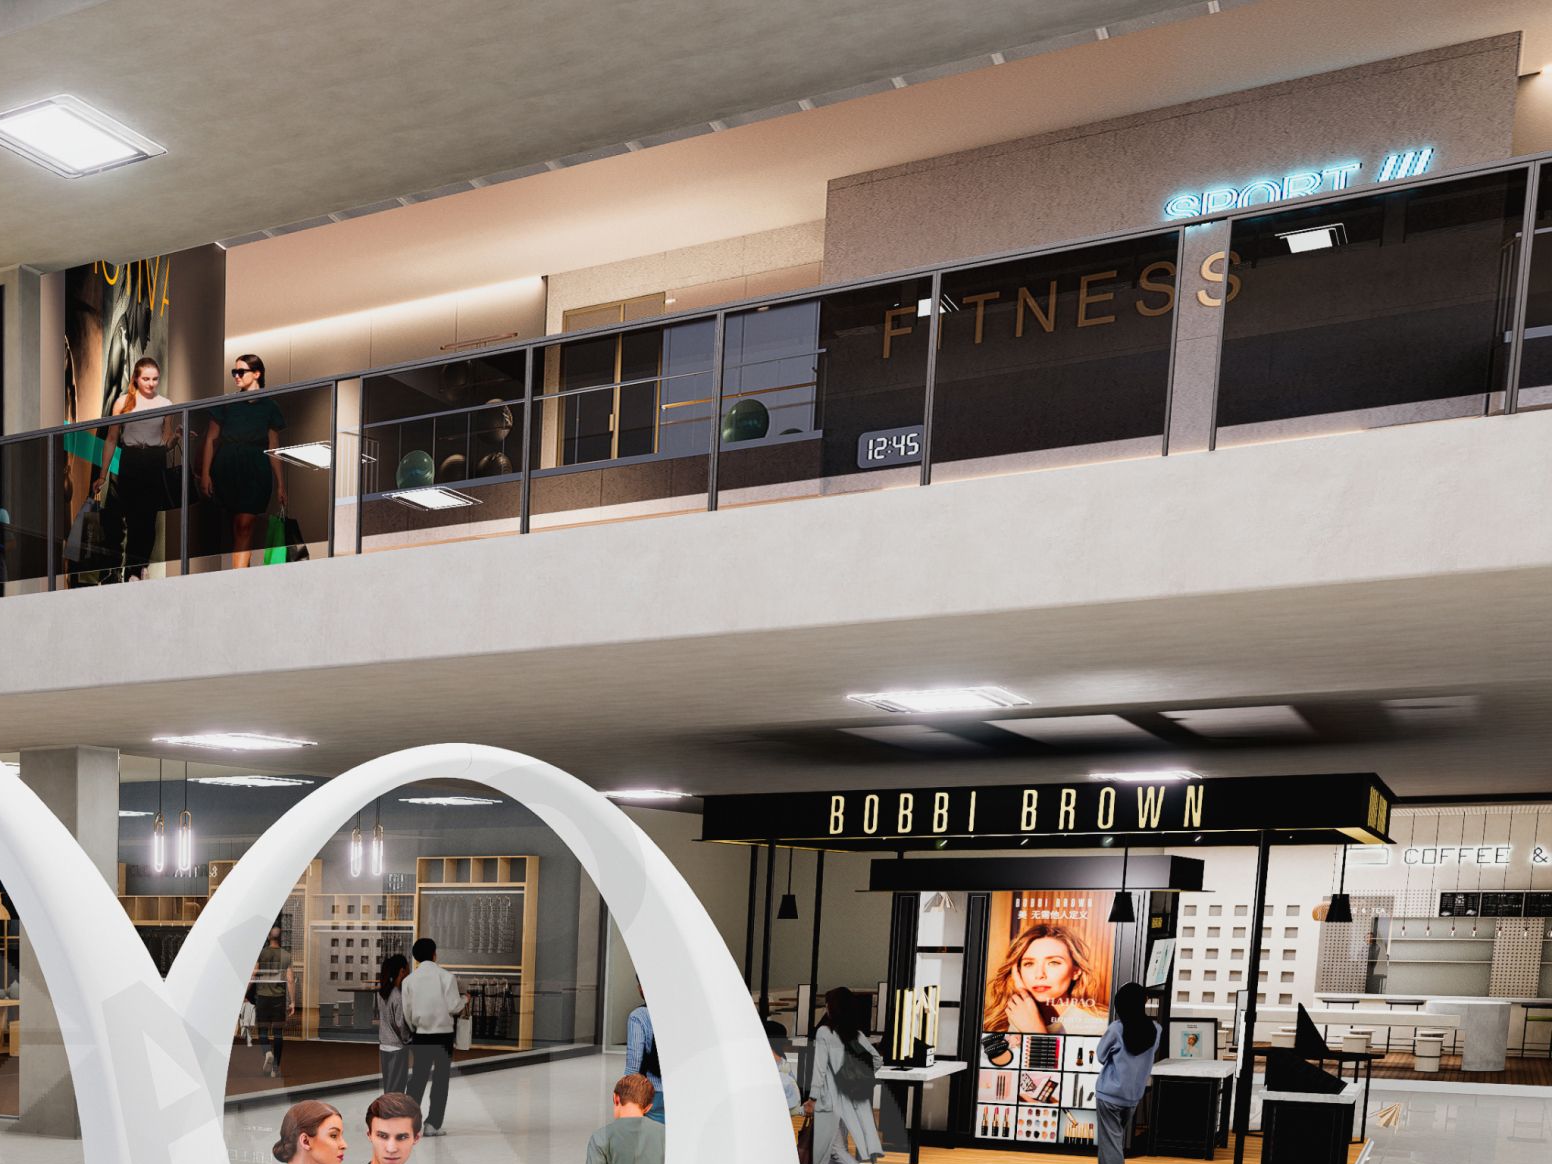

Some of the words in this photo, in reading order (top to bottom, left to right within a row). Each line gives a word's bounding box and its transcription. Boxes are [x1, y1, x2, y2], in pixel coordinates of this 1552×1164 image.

[1165, 162, 1362, 222] SPORT
[882, 250, 1242, 359] FITNESS
[868, 433, 920, 460] 12:45
[829, 790, 976, 834] BOBBI
[1020, 785, 1205, 832] BROWN
[1404, 847, 1511, 865] COFFEE
[1533, 846, 1548, 864] &
